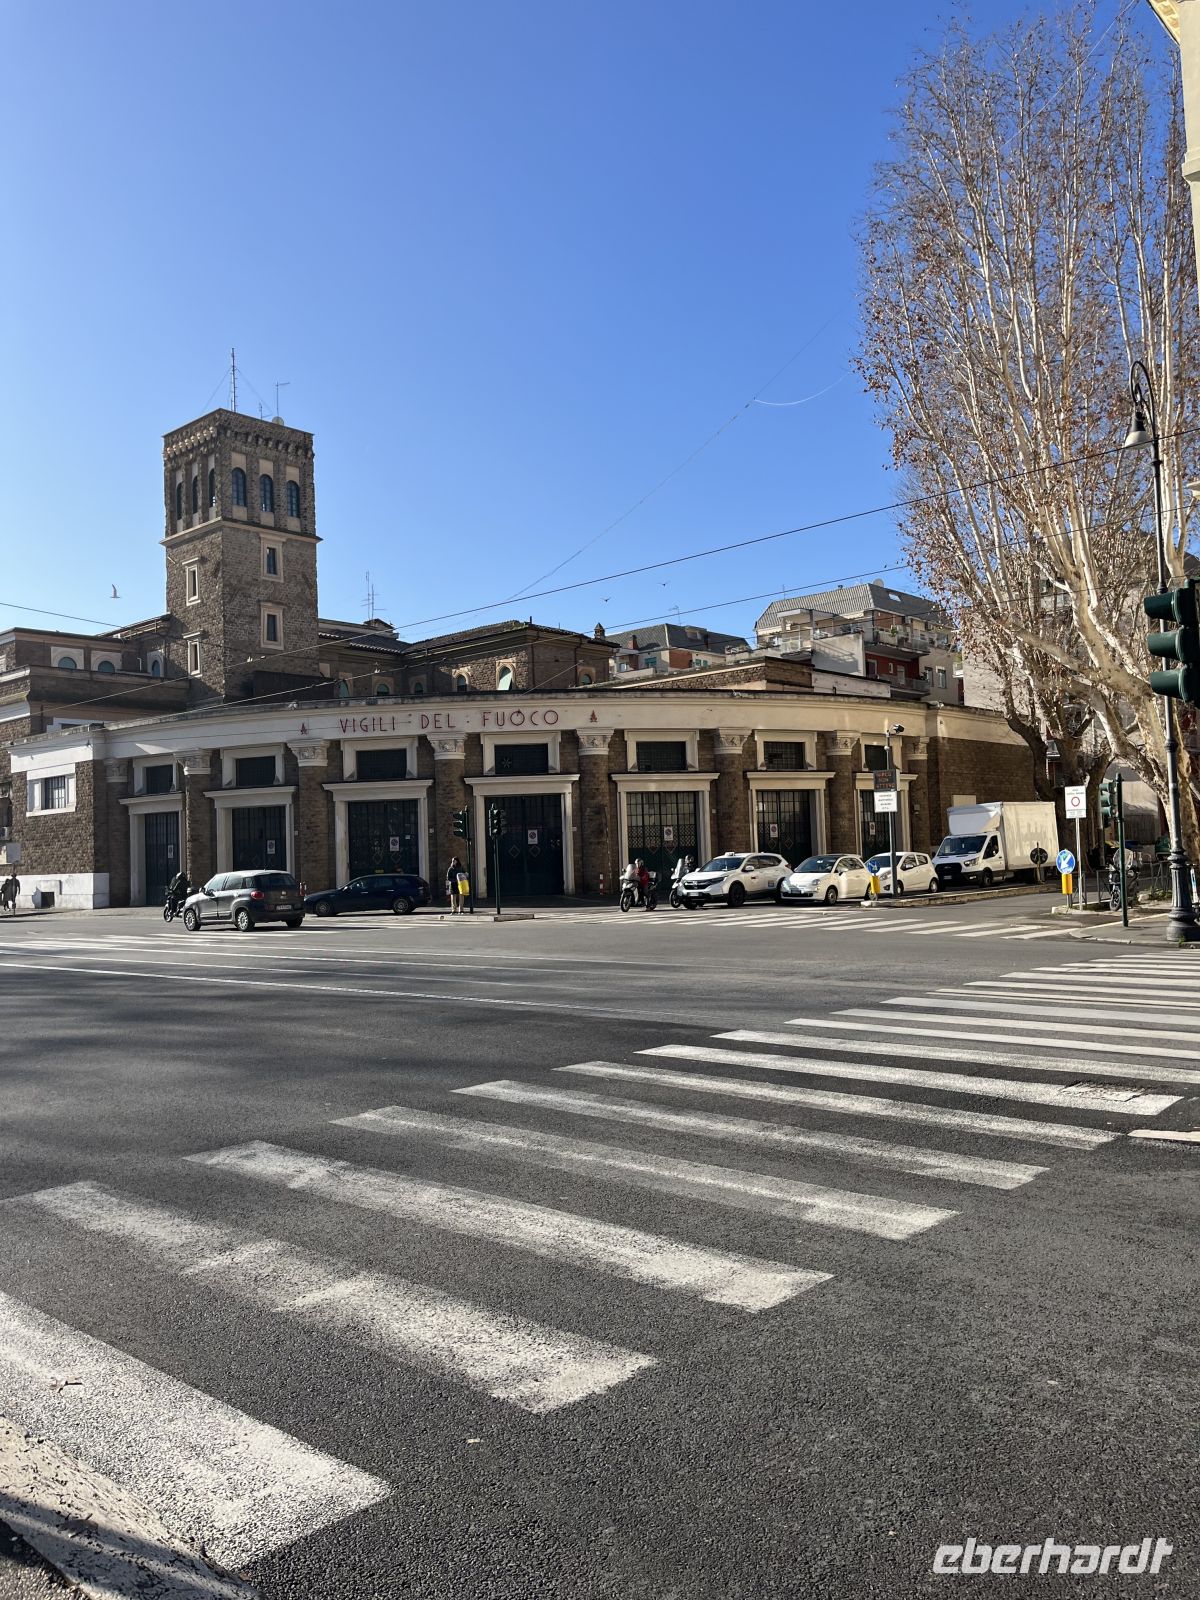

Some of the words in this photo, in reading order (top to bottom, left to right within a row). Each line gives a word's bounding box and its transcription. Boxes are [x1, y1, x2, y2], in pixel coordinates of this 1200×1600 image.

[339, 716, 396, 734] VIGILI
[421, 713, 457, 729] DEL
[483, 709, 559, 727] FUOCO
